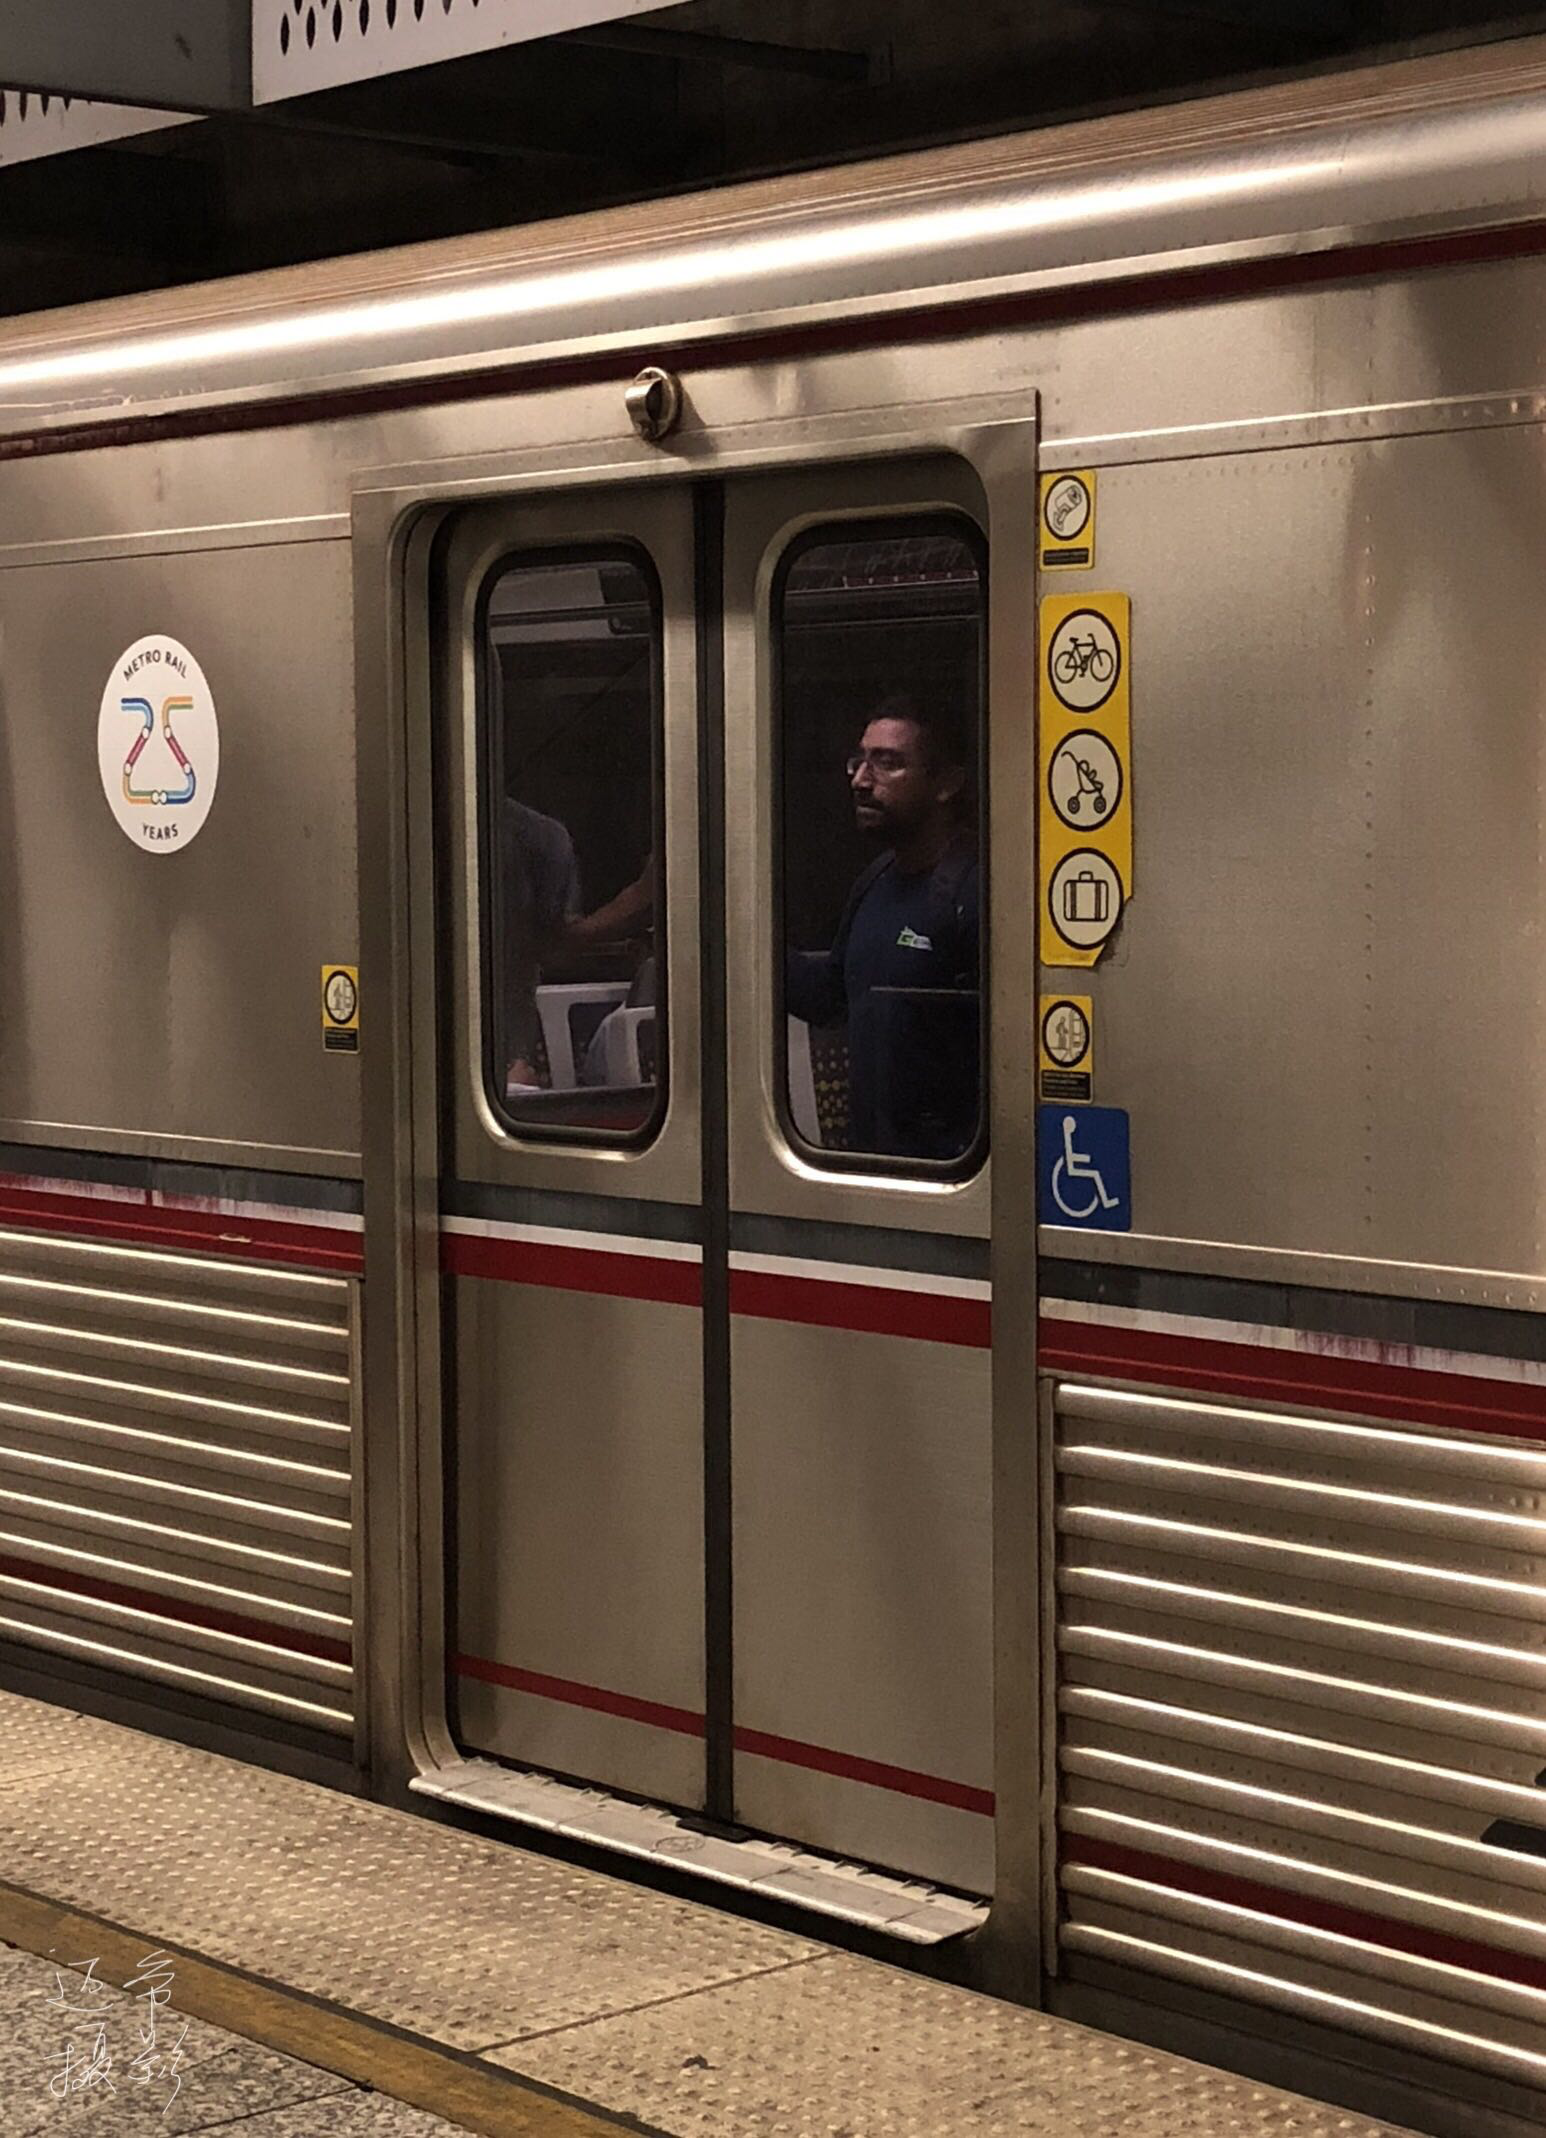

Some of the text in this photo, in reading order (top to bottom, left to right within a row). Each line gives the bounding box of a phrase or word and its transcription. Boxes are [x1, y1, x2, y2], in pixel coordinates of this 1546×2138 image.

[122, 649, 188, 682] METRO RAIL
[141, 822, 179, 840] YEARS
